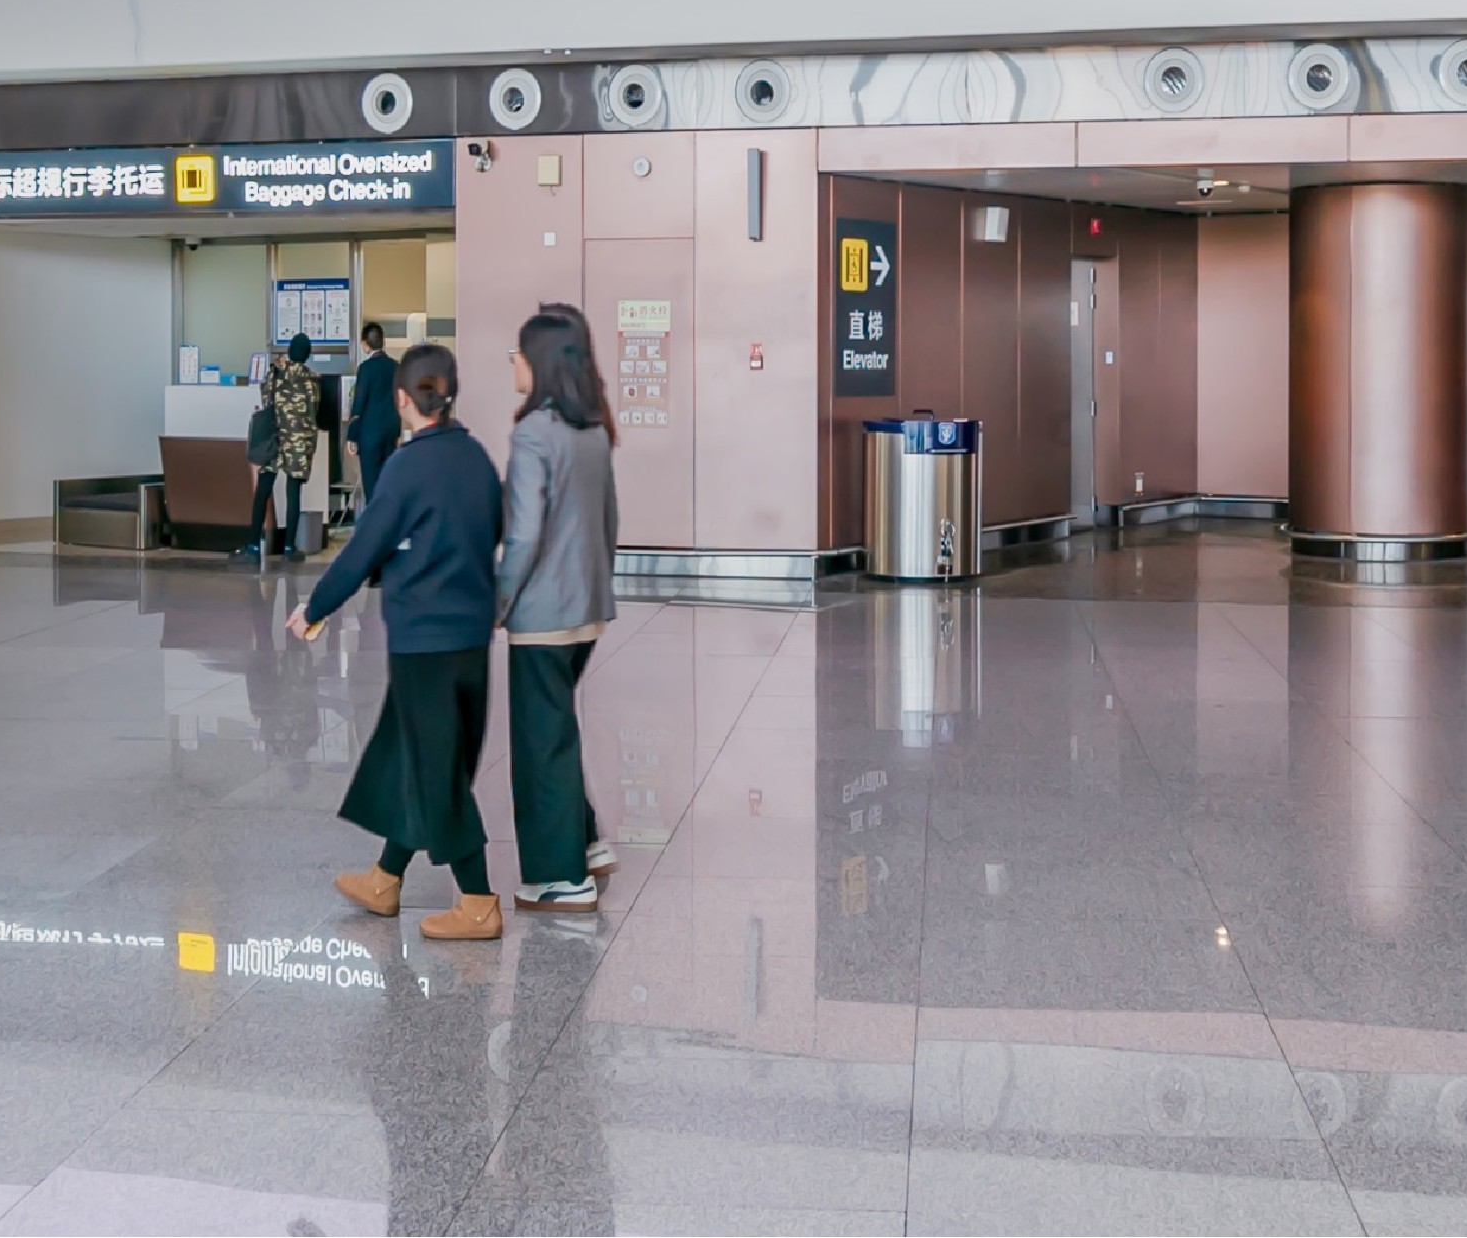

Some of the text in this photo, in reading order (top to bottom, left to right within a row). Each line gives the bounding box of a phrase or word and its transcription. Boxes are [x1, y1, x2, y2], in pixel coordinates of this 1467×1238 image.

[223, 150, 432, 177] International Oversized
[245, 177, 411, 207] Baggage Check-in
[848, 309, 884, 341] 直梯
[843, 349, 889, 370] Elevator
